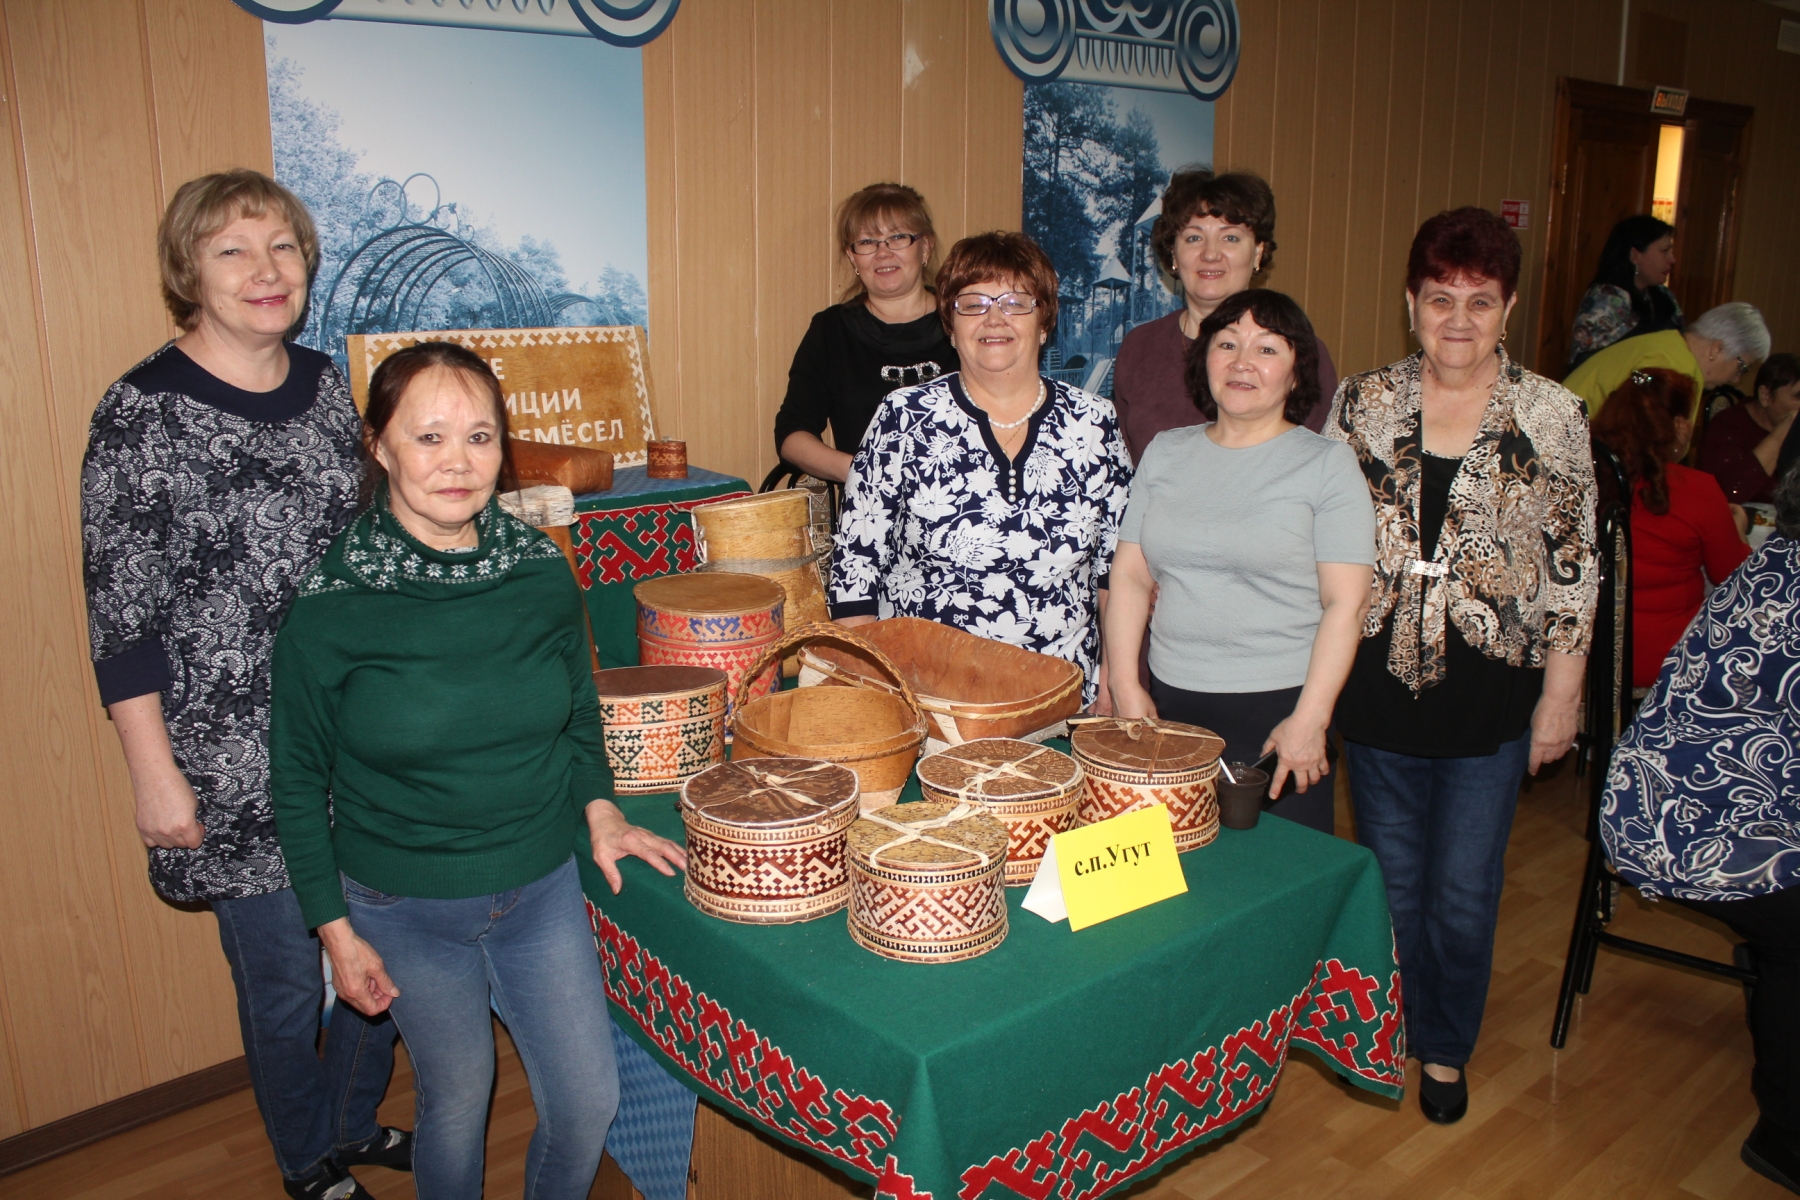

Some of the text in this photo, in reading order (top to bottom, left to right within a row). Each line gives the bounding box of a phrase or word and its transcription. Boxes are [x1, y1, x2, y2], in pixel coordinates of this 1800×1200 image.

[1655, 92, 1685, 111] ВЫХОД
[502, 388, 582, 419] ИЦИИ
[1074, 841, 1151, 877] с.п.Угут
